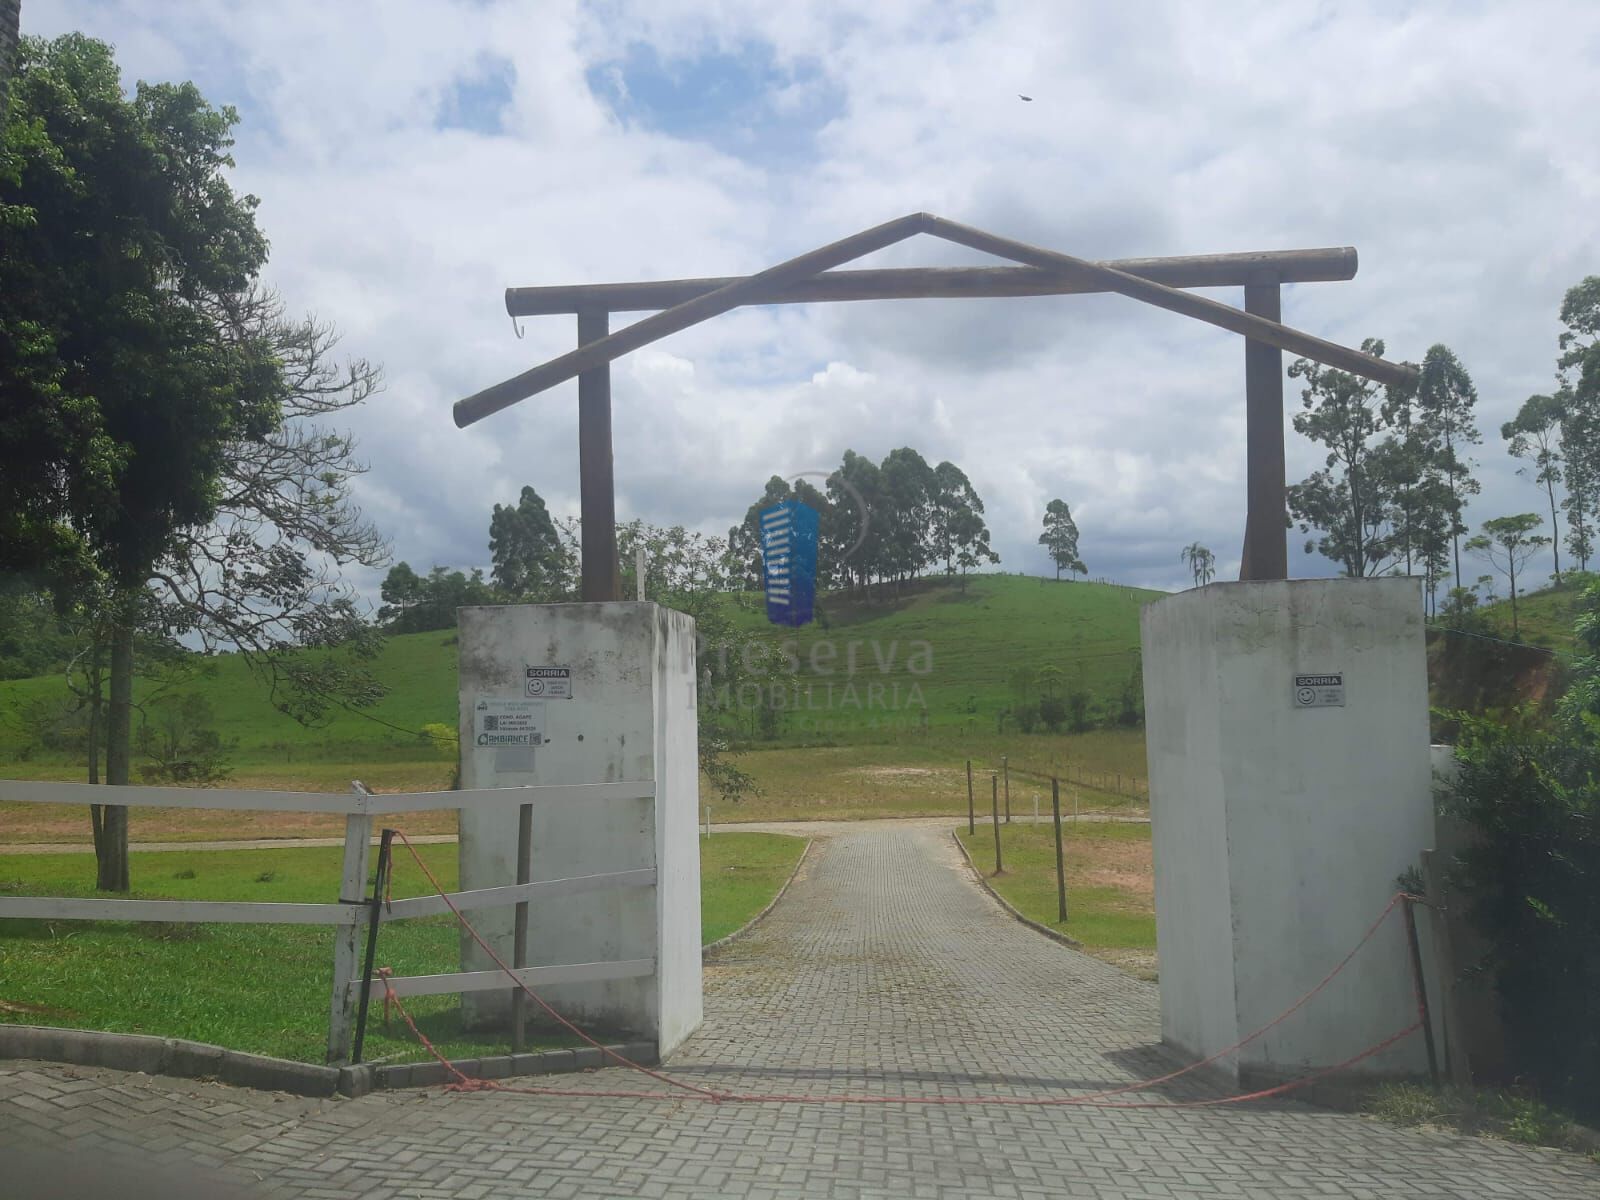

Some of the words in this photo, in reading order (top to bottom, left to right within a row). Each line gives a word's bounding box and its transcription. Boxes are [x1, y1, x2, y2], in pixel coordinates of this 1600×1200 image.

[529, 669, 567, 677] SORRIA
[1298, 677, 1338, 686] SORRIA
[488, 735, 529, 743] AMBIANCE
